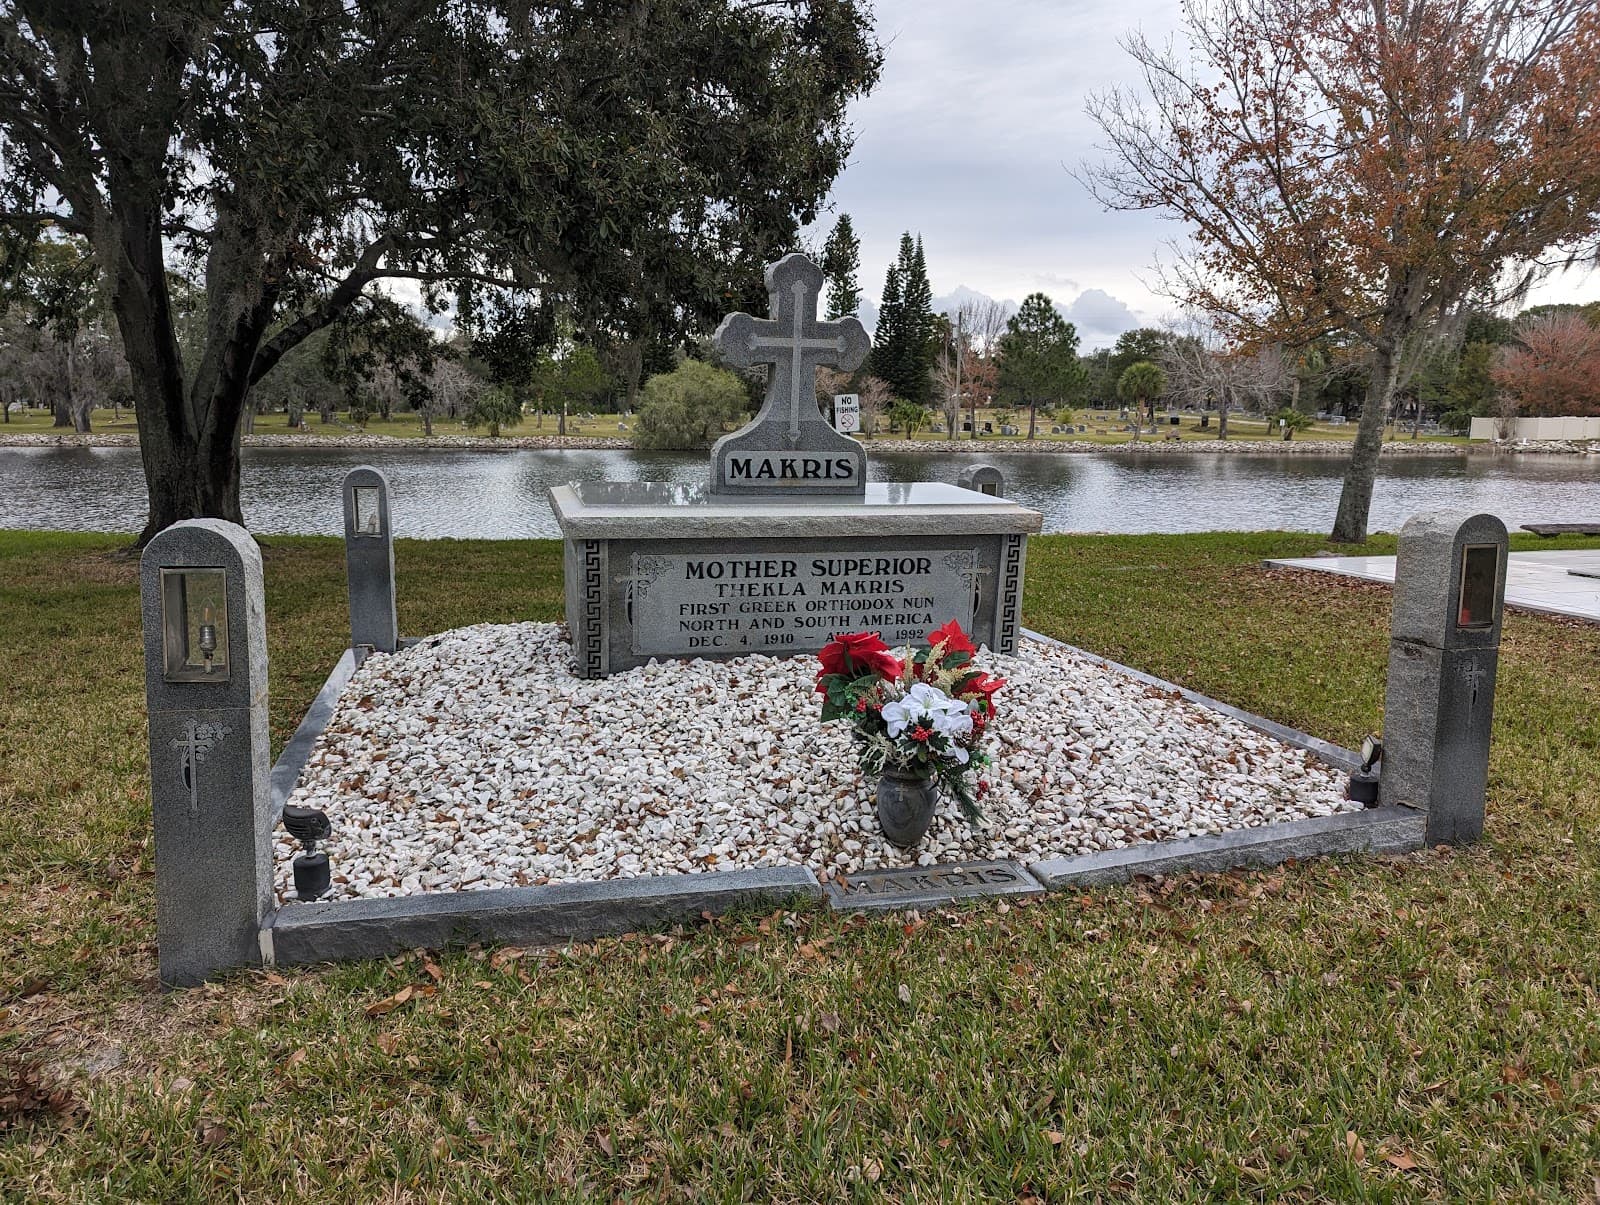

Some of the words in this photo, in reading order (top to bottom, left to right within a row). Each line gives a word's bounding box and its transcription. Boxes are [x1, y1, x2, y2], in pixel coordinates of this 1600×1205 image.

[836, 406, 858, 414] FISHING
[841, 396, 852, 405] NO
[730, 459, 853, 478] MAKRIS
[686, 560, 797, 580] MOTHER
[811, 558, 931, 576] SUPERIOR
[715, 583, 806, 598] THEKLA
[820, 579, 904, 595] MAKRIS
[679, 602, 730, 616] FIRST
[739, 601, 797, 614] GREEK
[805, 598, 895, 612] ORTHODOX
[903, 597, 935, 608] NUN
[679, 618, 739, 632] NORTH
[748, 618, 785, 630] AND
[794, 615, 850, 629] SOUTH
[859, 613, 933, 626] AMERICA
[689, 636, 728, 648] DEC.
[764, 633, 794, 645] 1910
[895, 629, 924, 640] 1992
[843, 868, 1018, 896] MAKRIS
